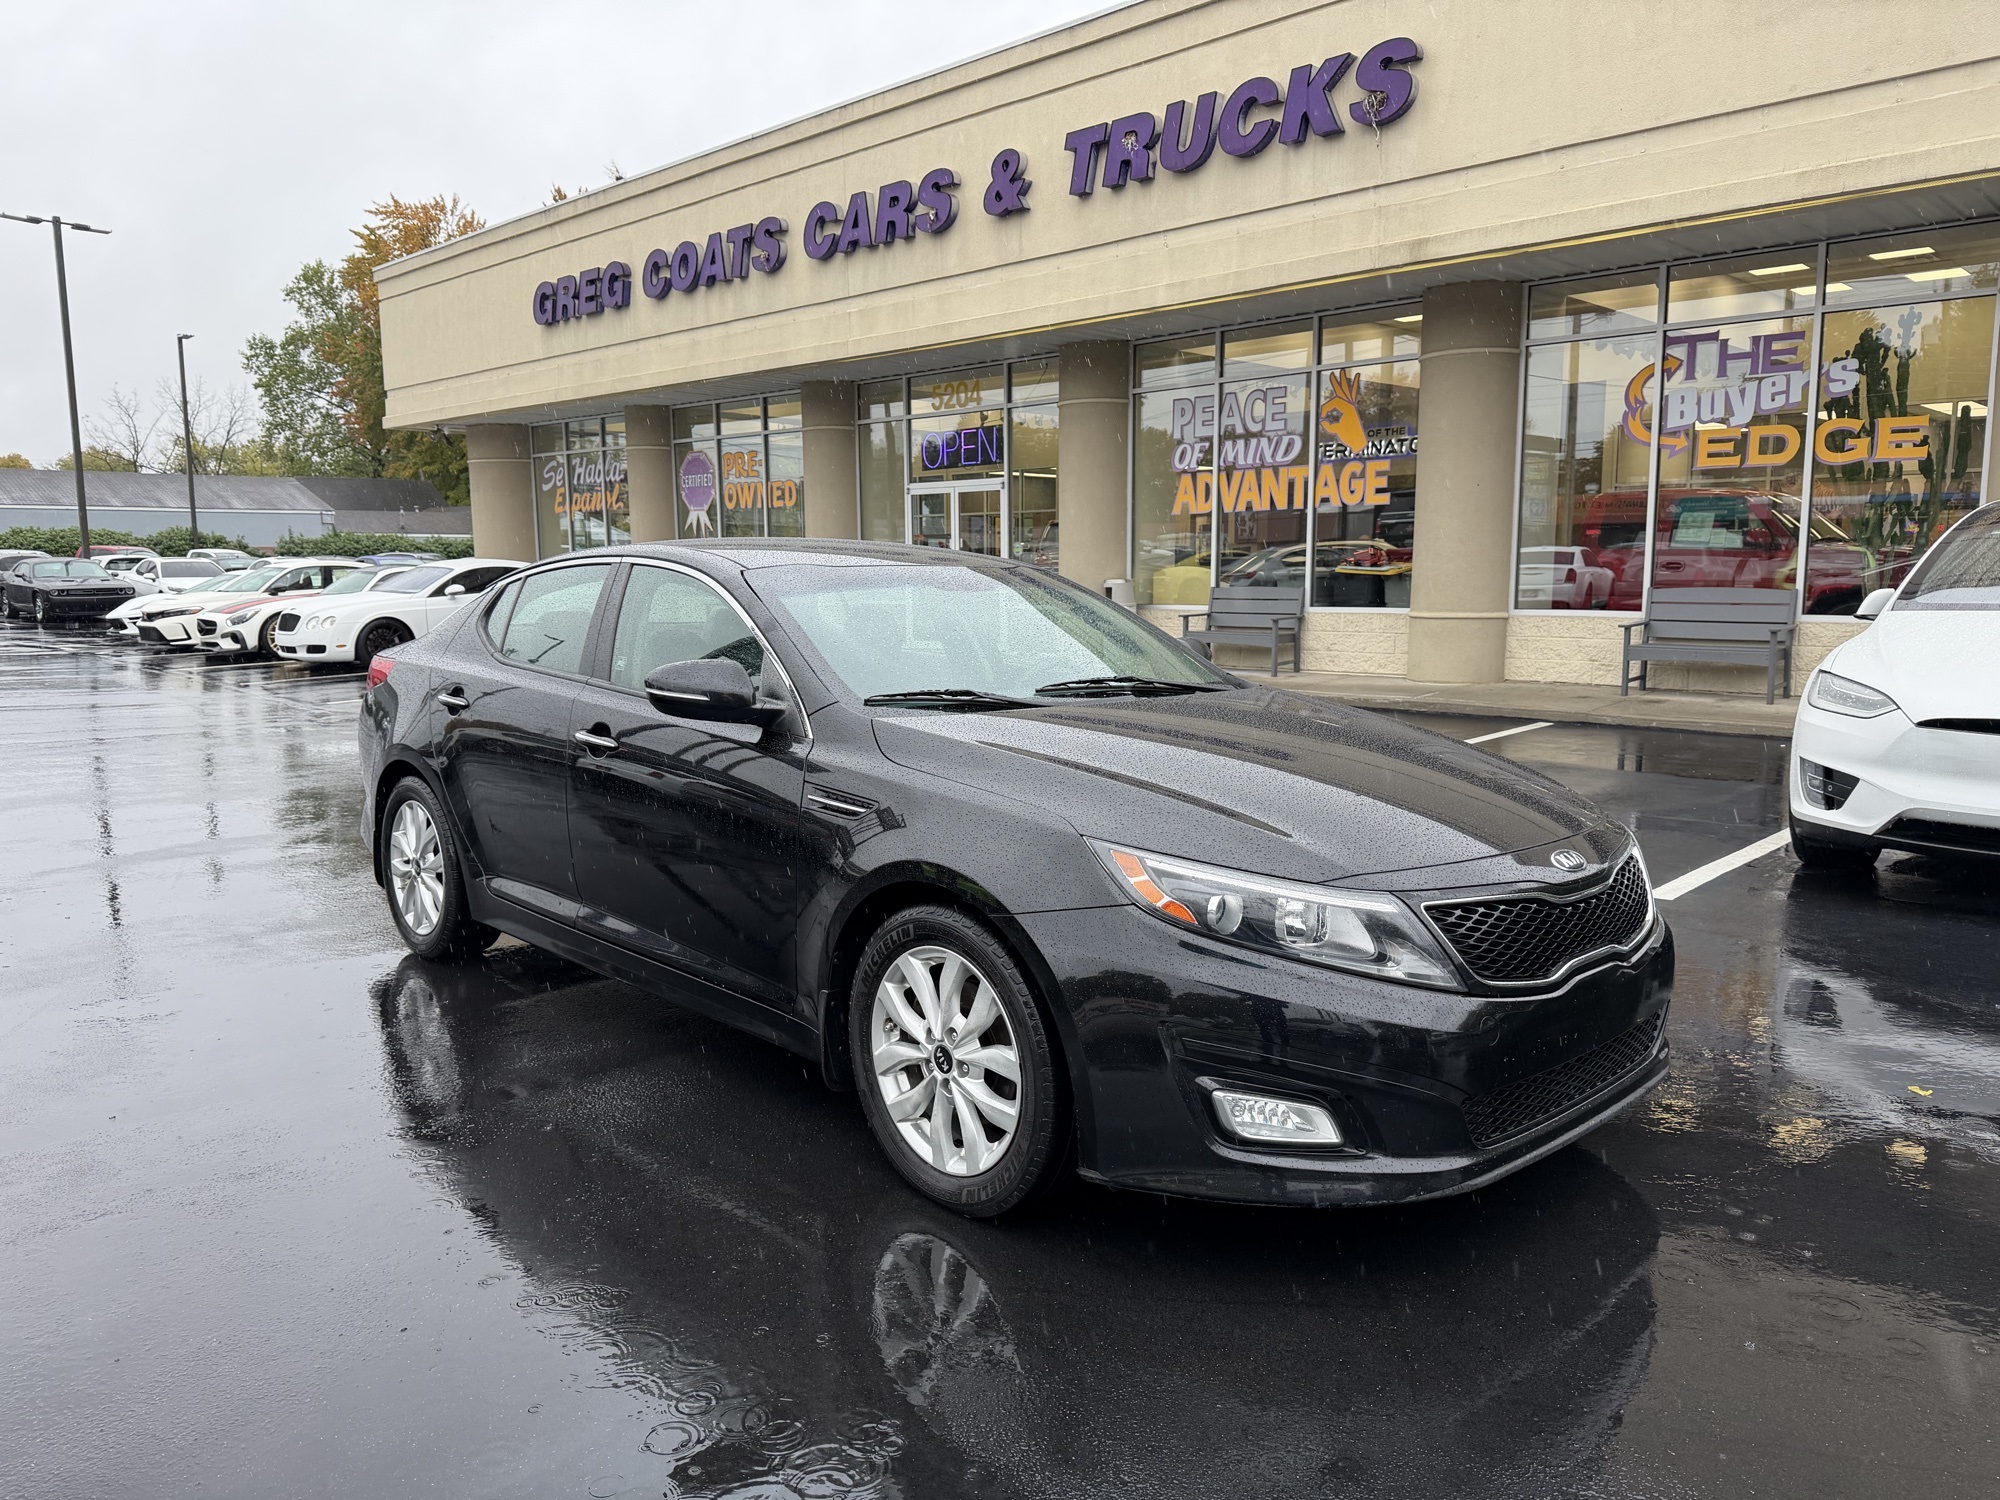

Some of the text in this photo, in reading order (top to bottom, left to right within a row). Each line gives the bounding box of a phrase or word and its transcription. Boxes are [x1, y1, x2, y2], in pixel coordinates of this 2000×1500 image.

[533, 37, 1423, 325] GREG COATS CARS & TRUCKS
[1665, 330, 1805, 383] THE
[931, 380, 982, 411] 5204
[1172, 386, 1288, 440] PEACE
[1663, 358, 1860, 432] Buyer's
[922, 426, 997, 468] OPEN
[1367, 426, 1406, 437] OF THE
[1692, 414, 1930, 471] EDGE
[542, 453, 625, 491] Se Habla
[1171, 434, 1303, 472] OF MIND
[681, 473, 713, 488] CERTIFIED
[724, 479, 797, 510] OWNED
[1171, 461, 1391, 516] ADVANTAGE
[860, 924, 913, 989] MICHELIN
[936, 1047, 950, 1072] KIA
